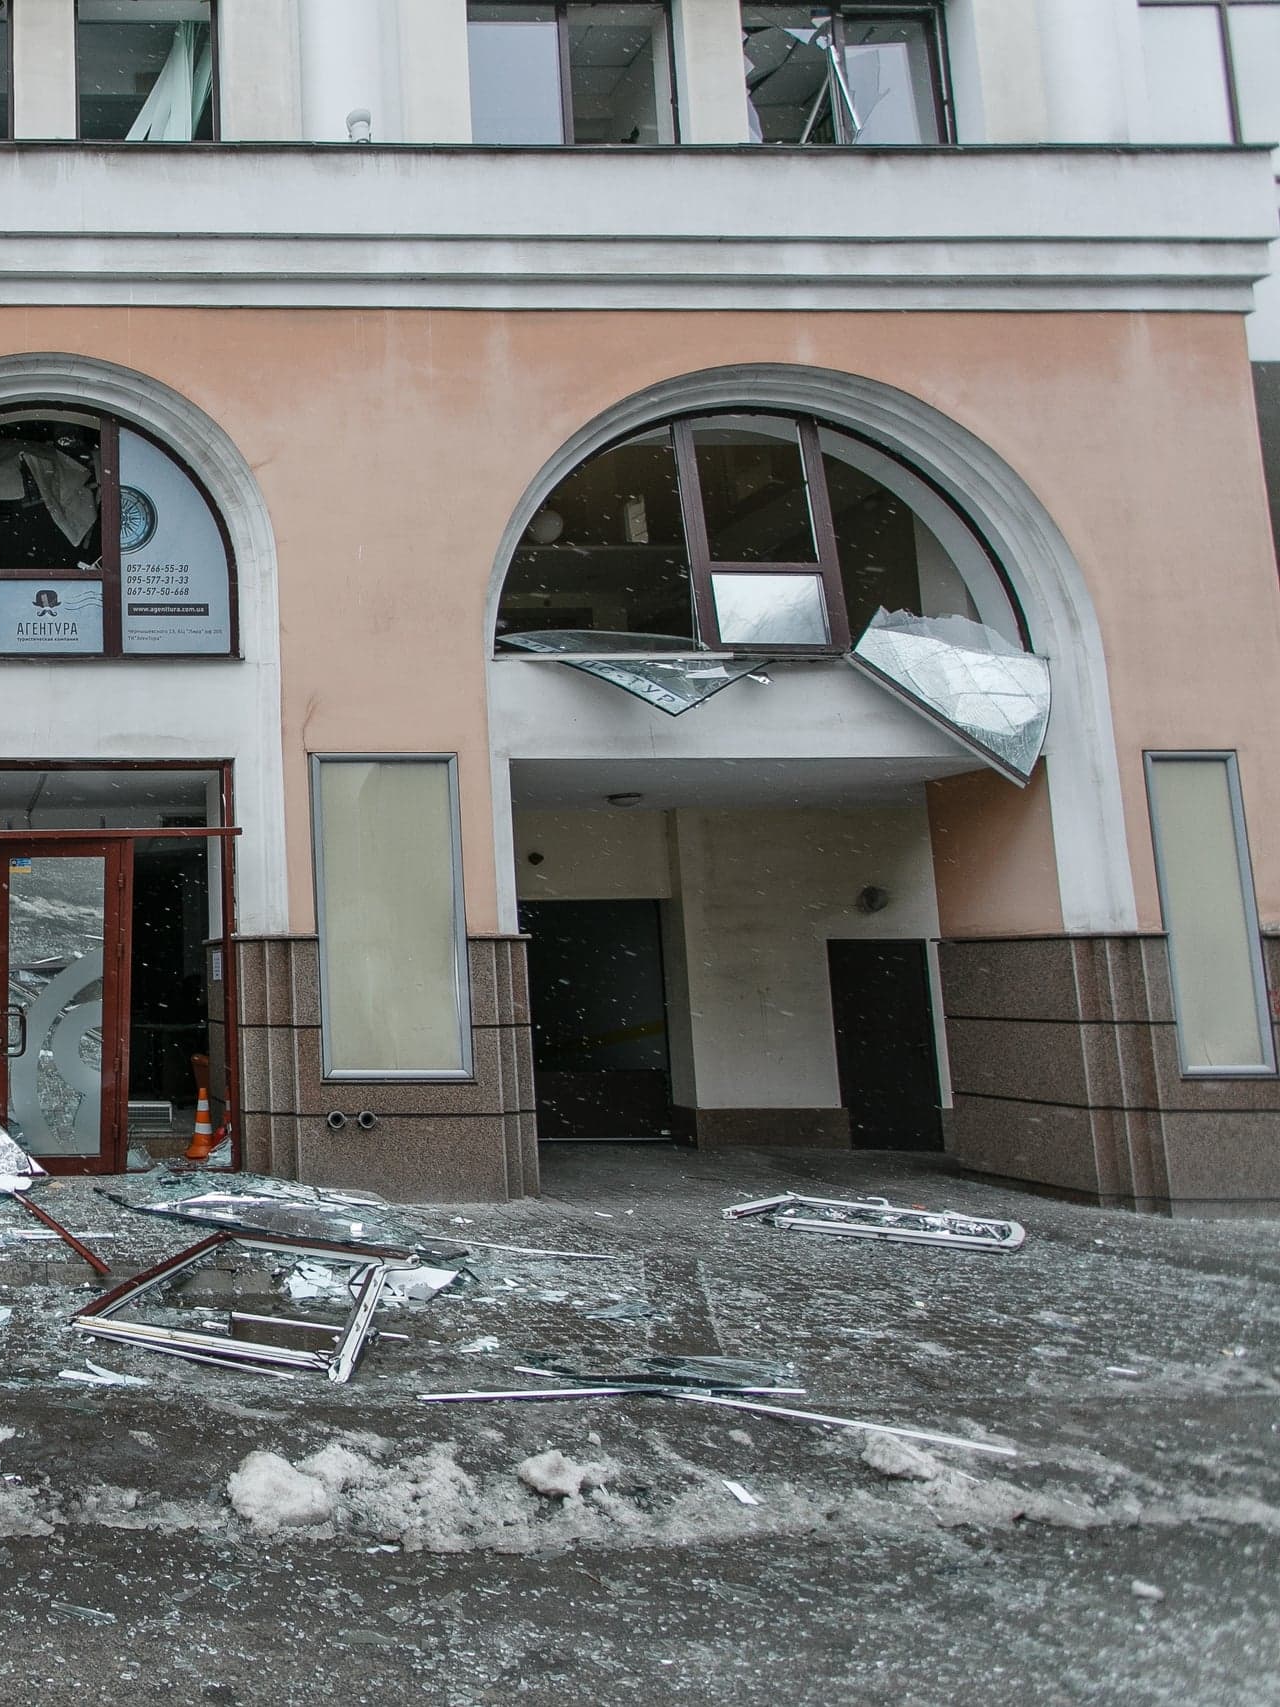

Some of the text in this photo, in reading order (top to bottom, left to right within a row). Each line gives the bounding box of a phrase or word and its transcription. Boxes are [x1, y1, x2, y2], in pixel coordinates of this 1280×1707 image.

[126, 564, 189, 573] 057-766-55-30
[127, 575, 189, 584] 095-577-31-33
[127, 587, 190, 596] 067-57-50-668
[16, 622, 78, 635] АГЕНТУРА
